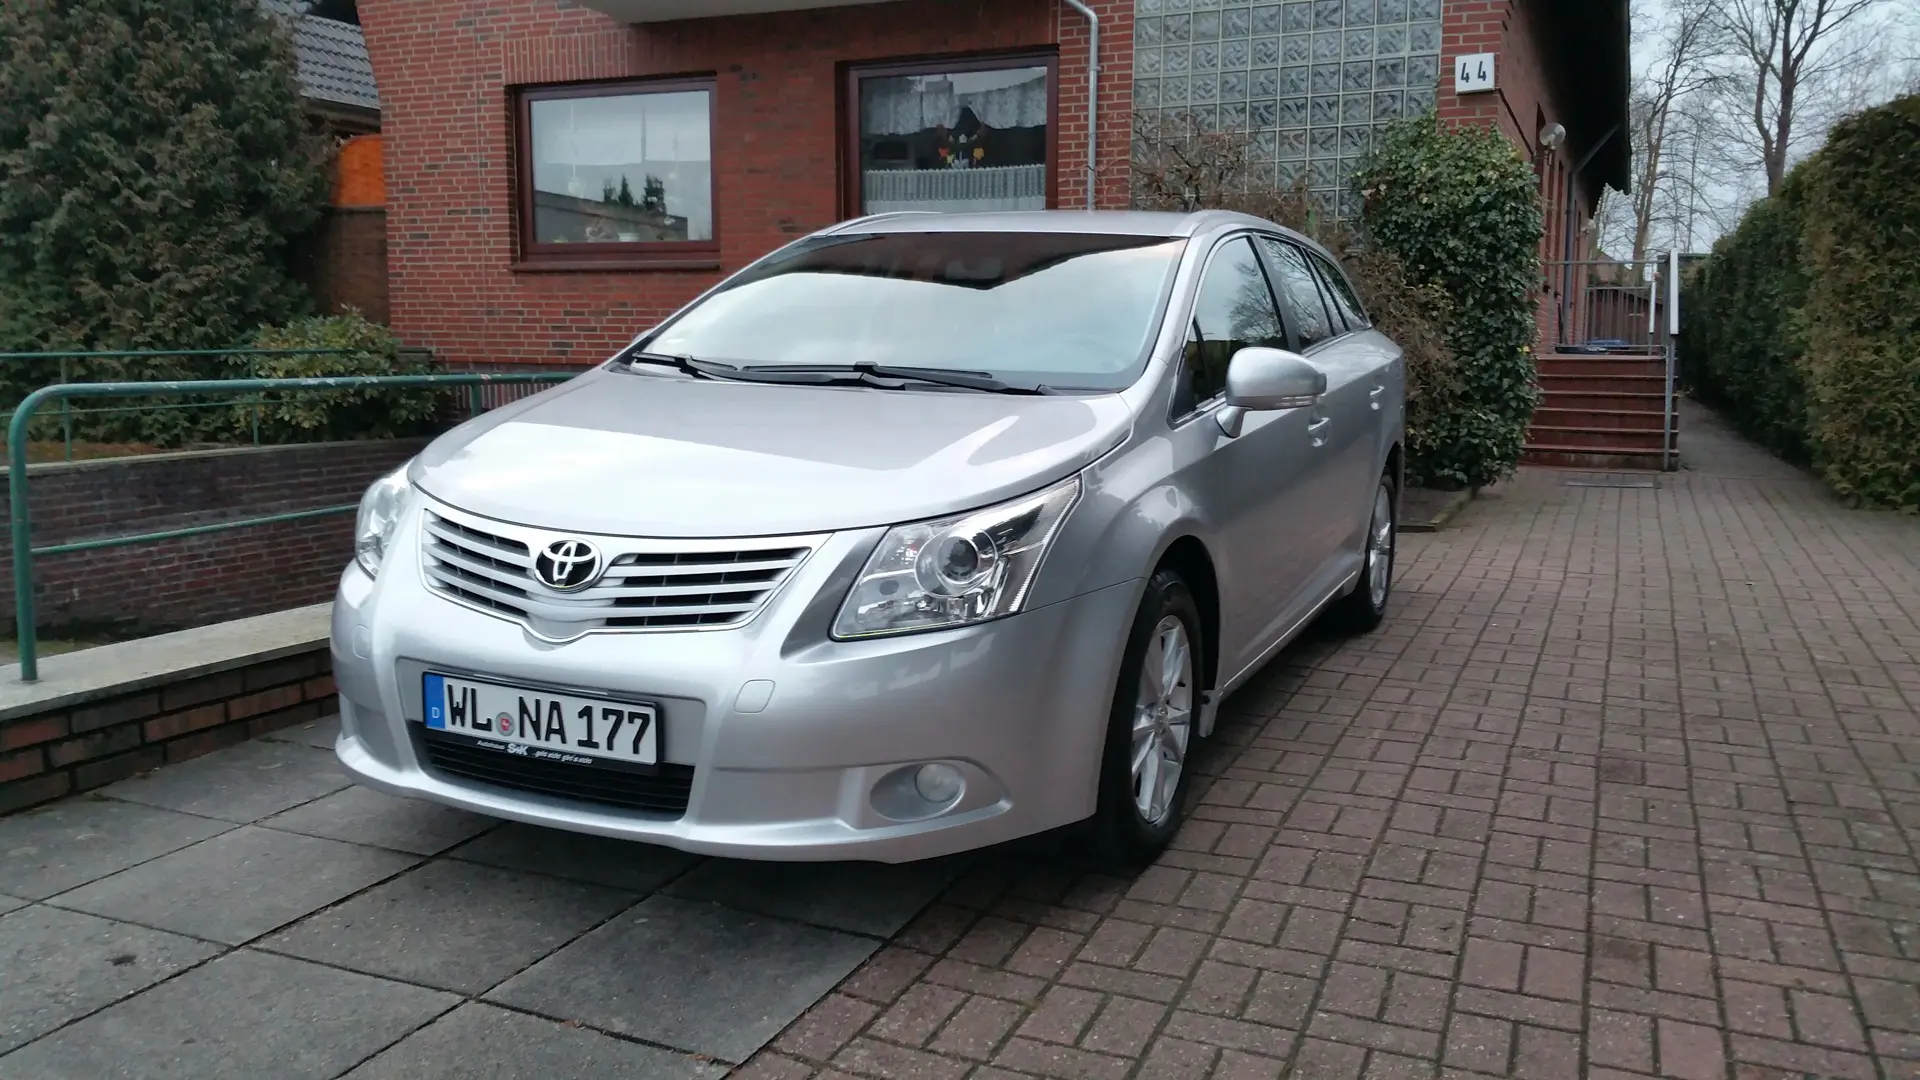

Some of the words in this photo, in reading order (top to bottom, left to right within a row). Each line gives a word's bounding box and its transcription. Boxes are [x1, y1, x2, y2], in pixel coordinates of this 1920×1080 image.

[1460, 61, 1487, 83] 44
[431, 706, 440, 719] D
[447, 684, 492, 732] WL
[518, 696, 567, 744] NA
[577, 705, 651, 755] 177
